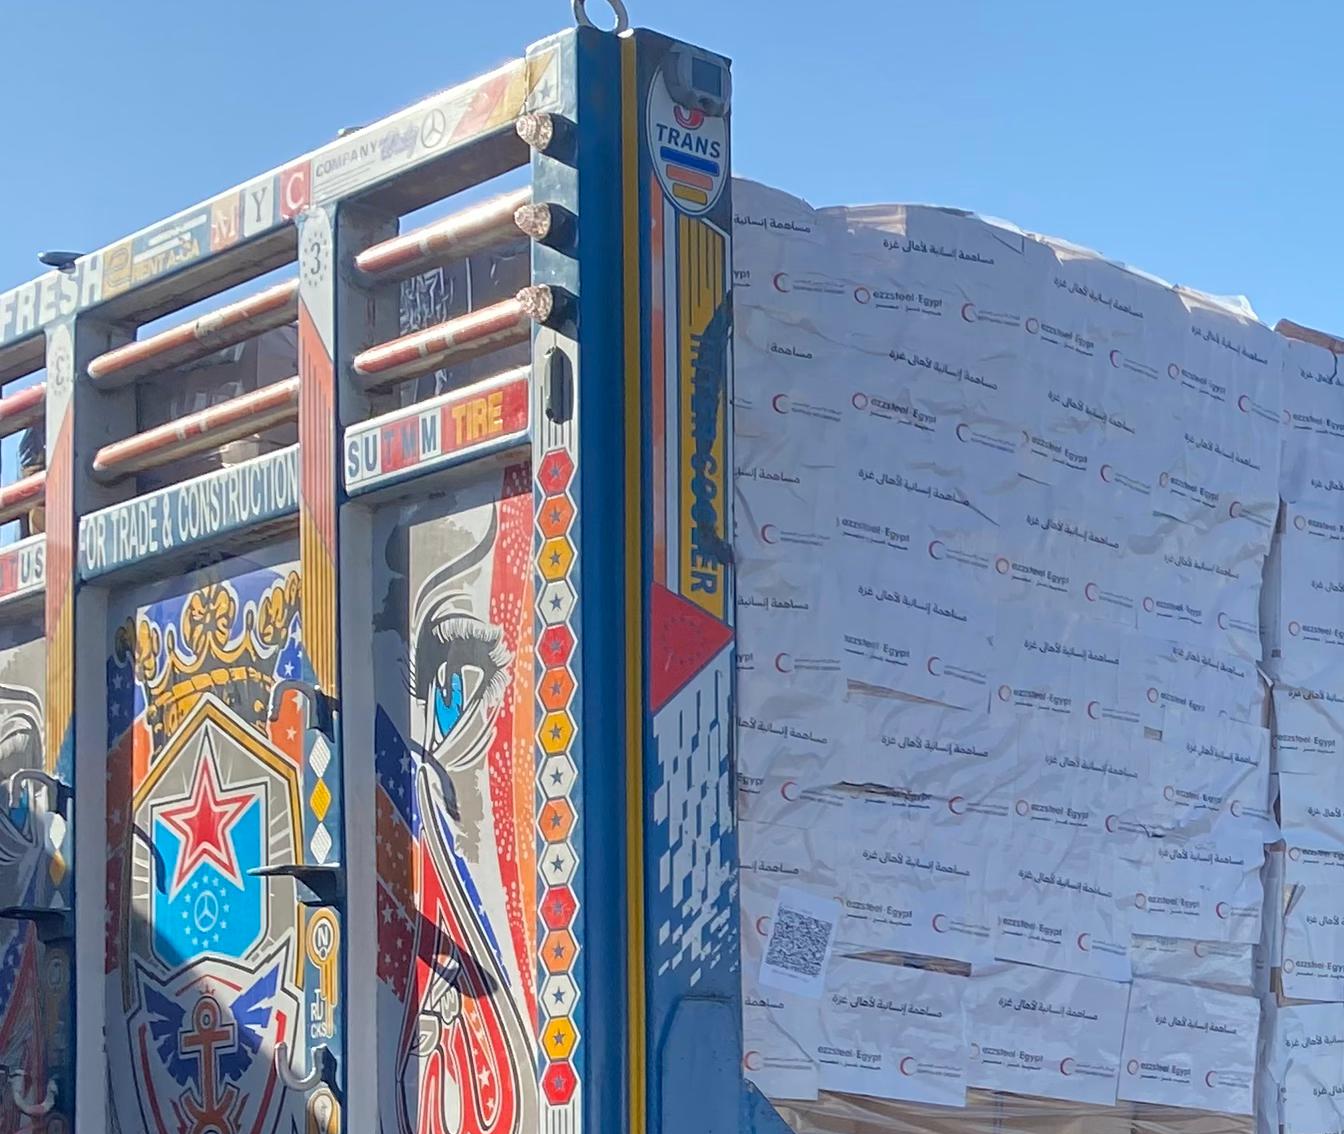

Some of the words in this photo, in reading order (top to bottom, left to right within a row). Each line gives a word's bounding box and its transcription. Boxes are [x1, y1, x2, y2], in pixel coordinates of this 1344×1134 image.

[315, 139, 378, 178] COMPANY
[656, 123, 721, 159] TRANS
[252, 187, 268, 223] Y
[286, 171, 305, 210] C
[734, 271, 751, 281] ypt
[451, 391, 503, 445] TIRE
[80, 517, 106, 571] FOR
[110, 499, 158, 563] TRADE
[161, 492, 173, 549] &
[177, 455, 299, 543] CONSTRUCTION
